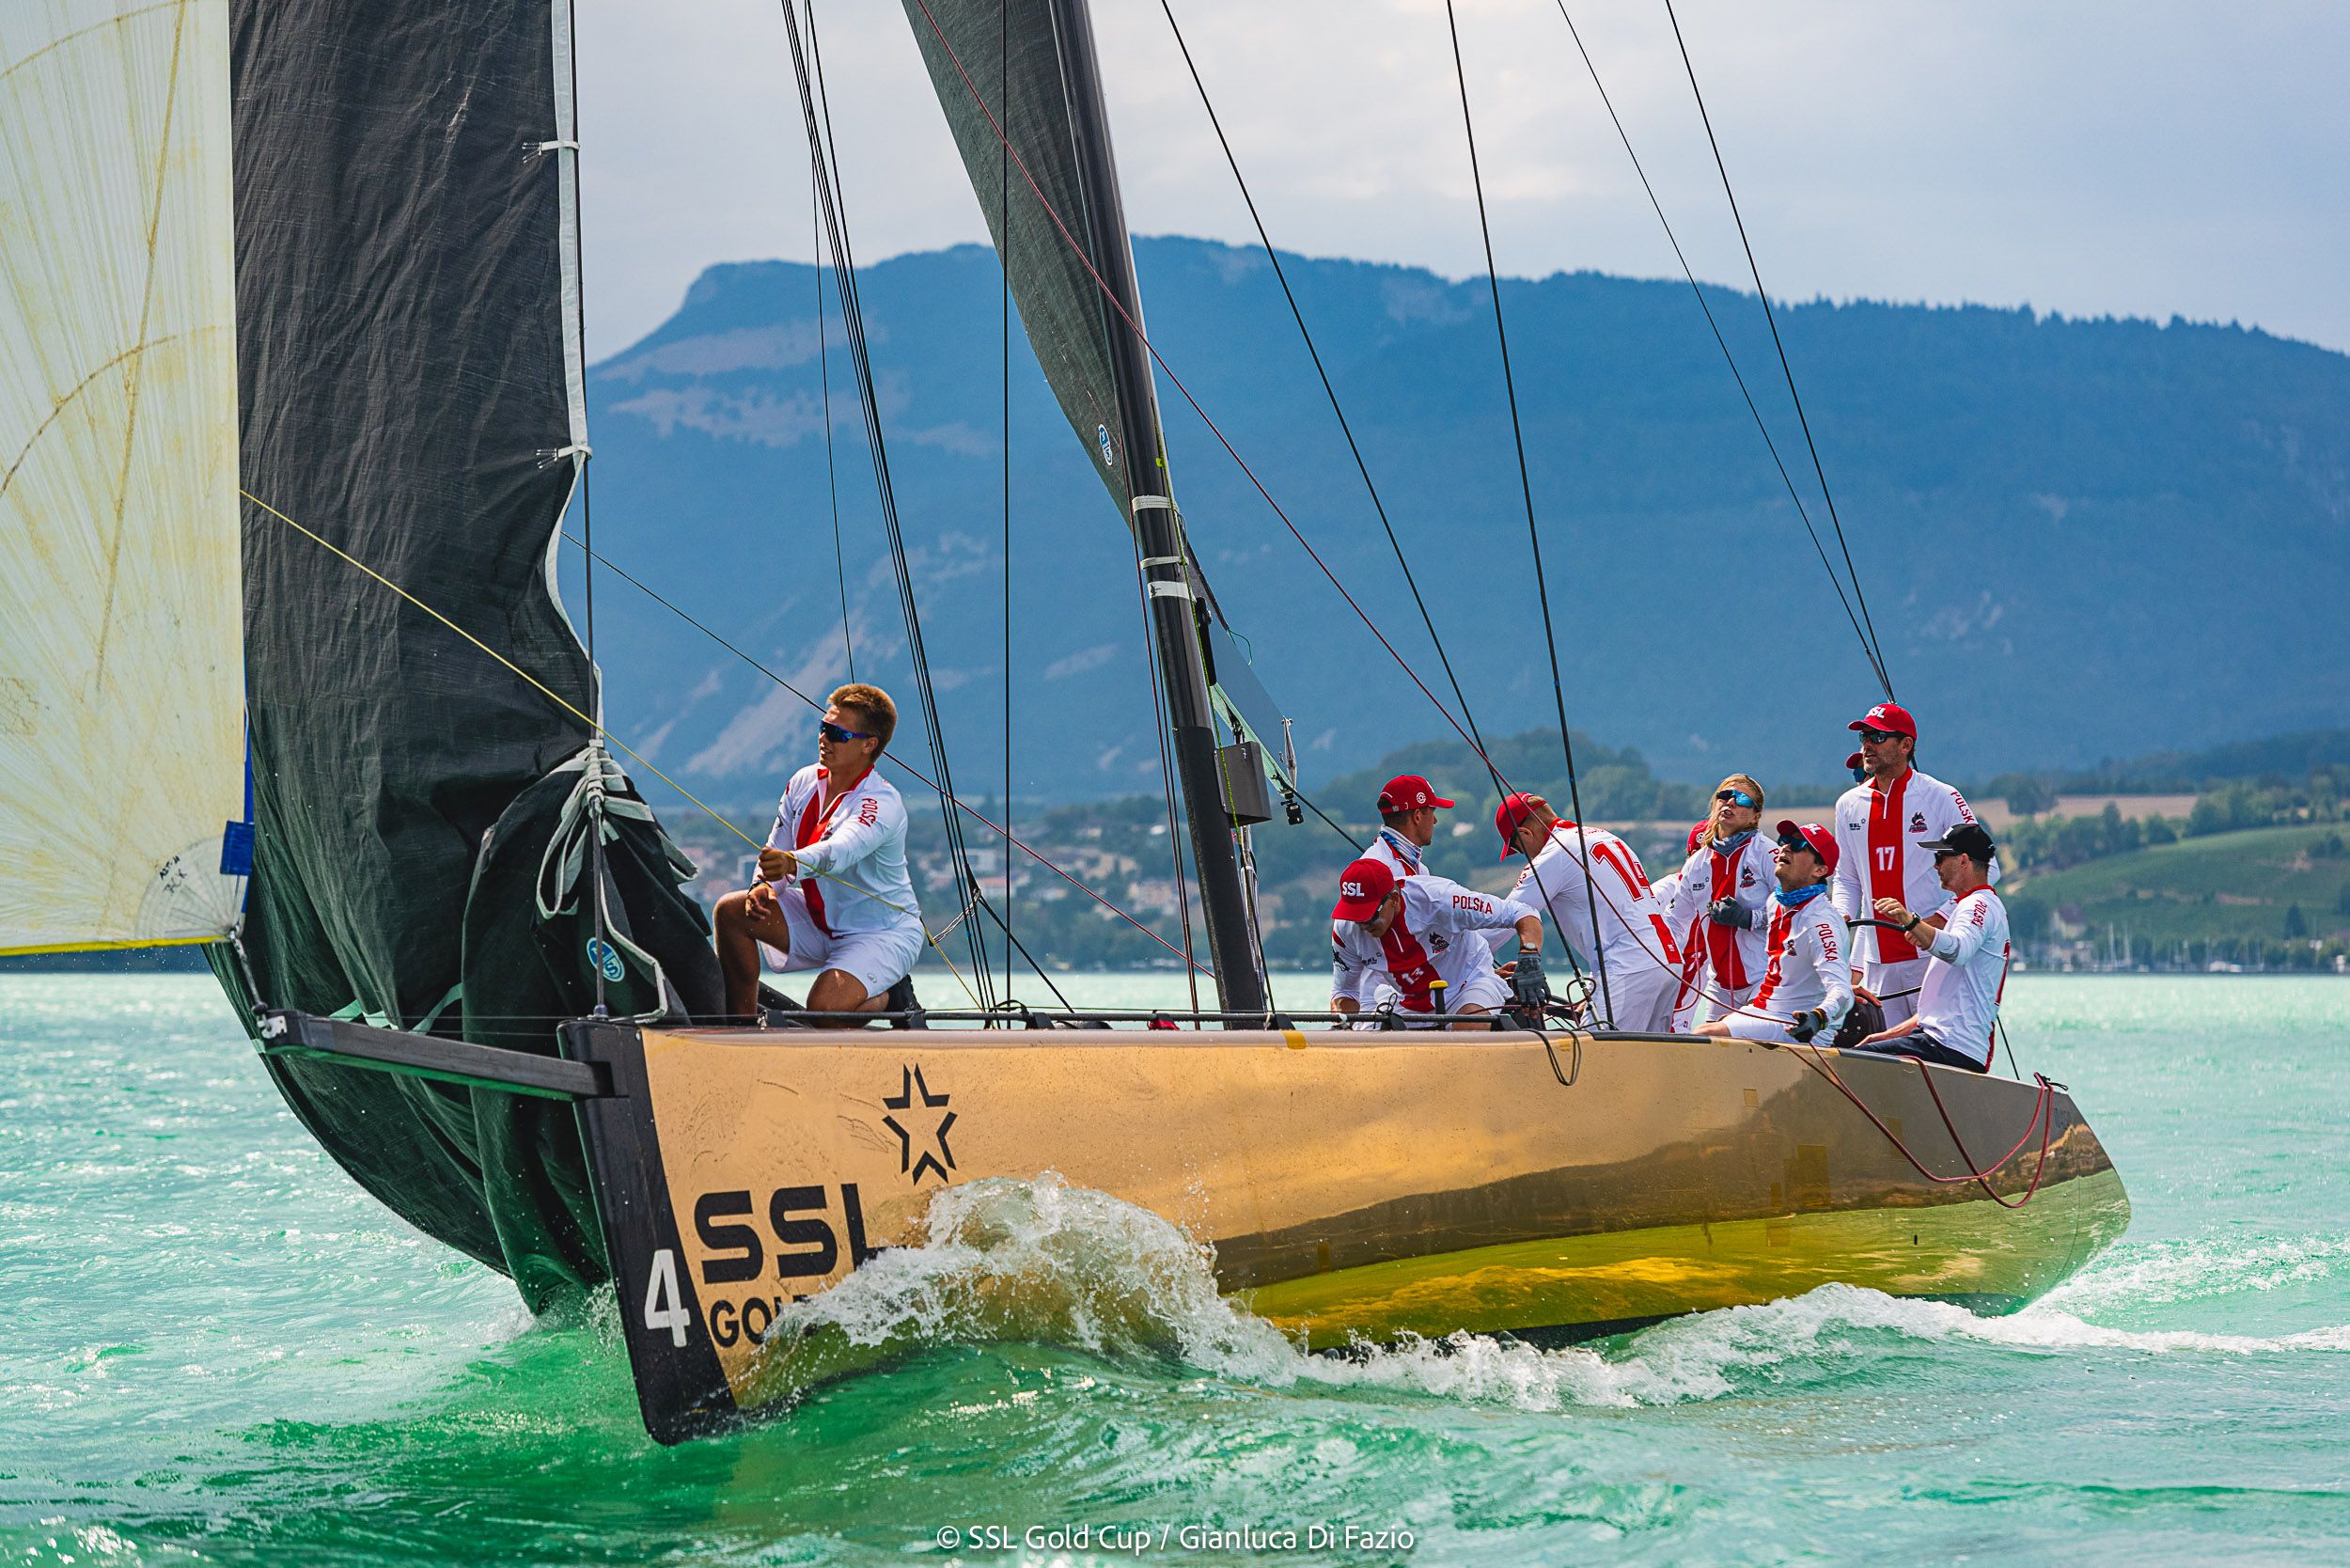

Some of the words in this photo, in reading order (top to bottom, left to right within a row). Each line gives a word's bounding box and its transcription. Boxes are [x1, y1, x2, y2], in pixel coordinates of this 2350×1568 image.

[1950, 791, 1980, 825] POLSK
[1875, 846, 1896, 871] 17
[1341, 881, 1365, 897] SSL
[1815, 922, 1839, 963] POLSKA
[694, 1182, 907, 1285] SSL
[644, 1248, 692, 1348] 4
